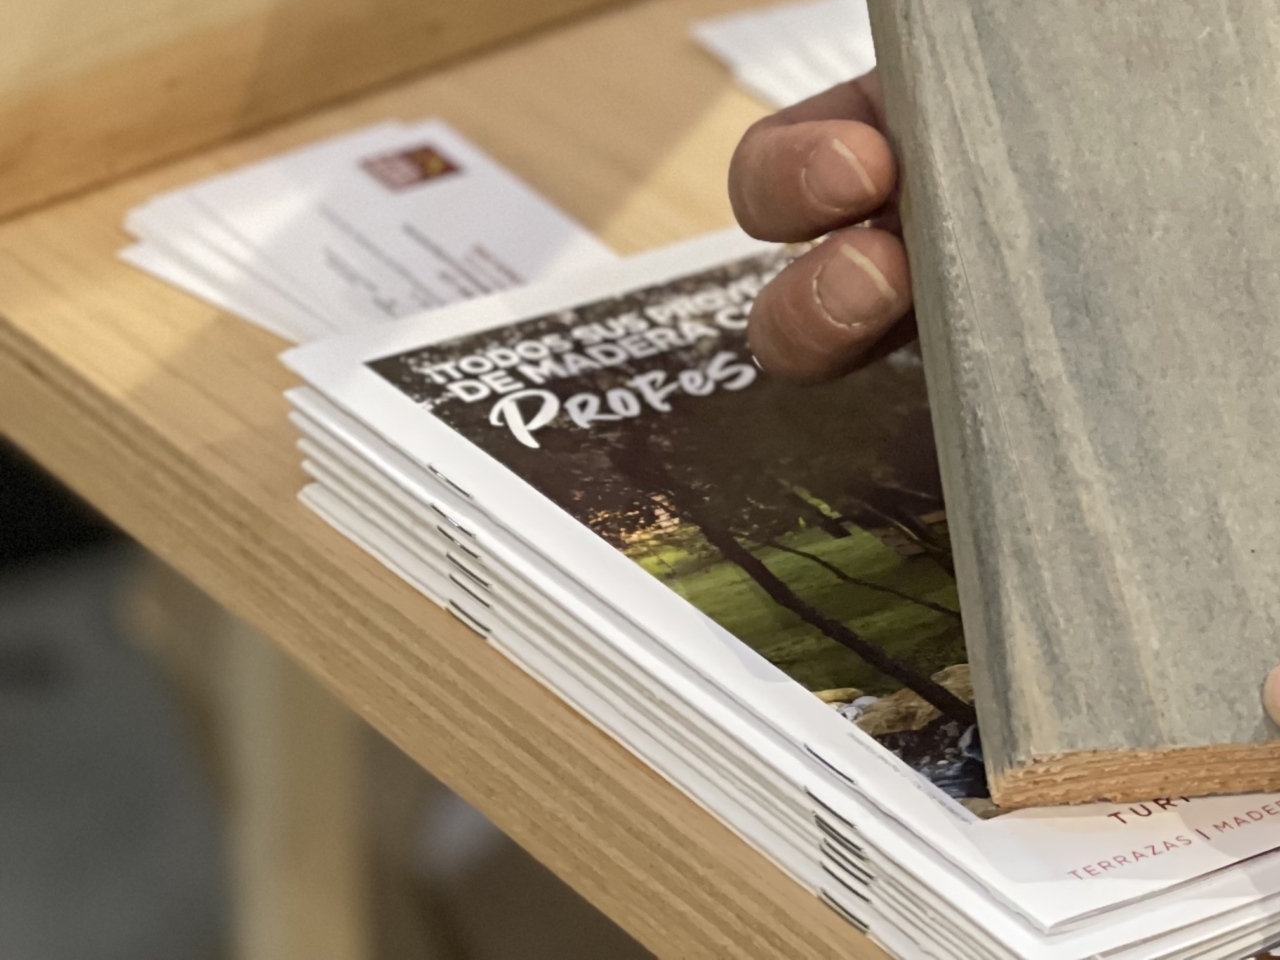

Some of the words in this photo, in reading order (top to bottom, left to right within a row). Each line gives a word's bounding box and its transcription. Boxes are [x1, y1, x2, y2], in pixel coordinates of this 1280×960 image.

[571, 310, 650, 345] SUS
[448, 368, 525, 404] DE
[516, 319, 721, 385] MADERA
[1067, 834, 1193, 882] TERRAZAS
